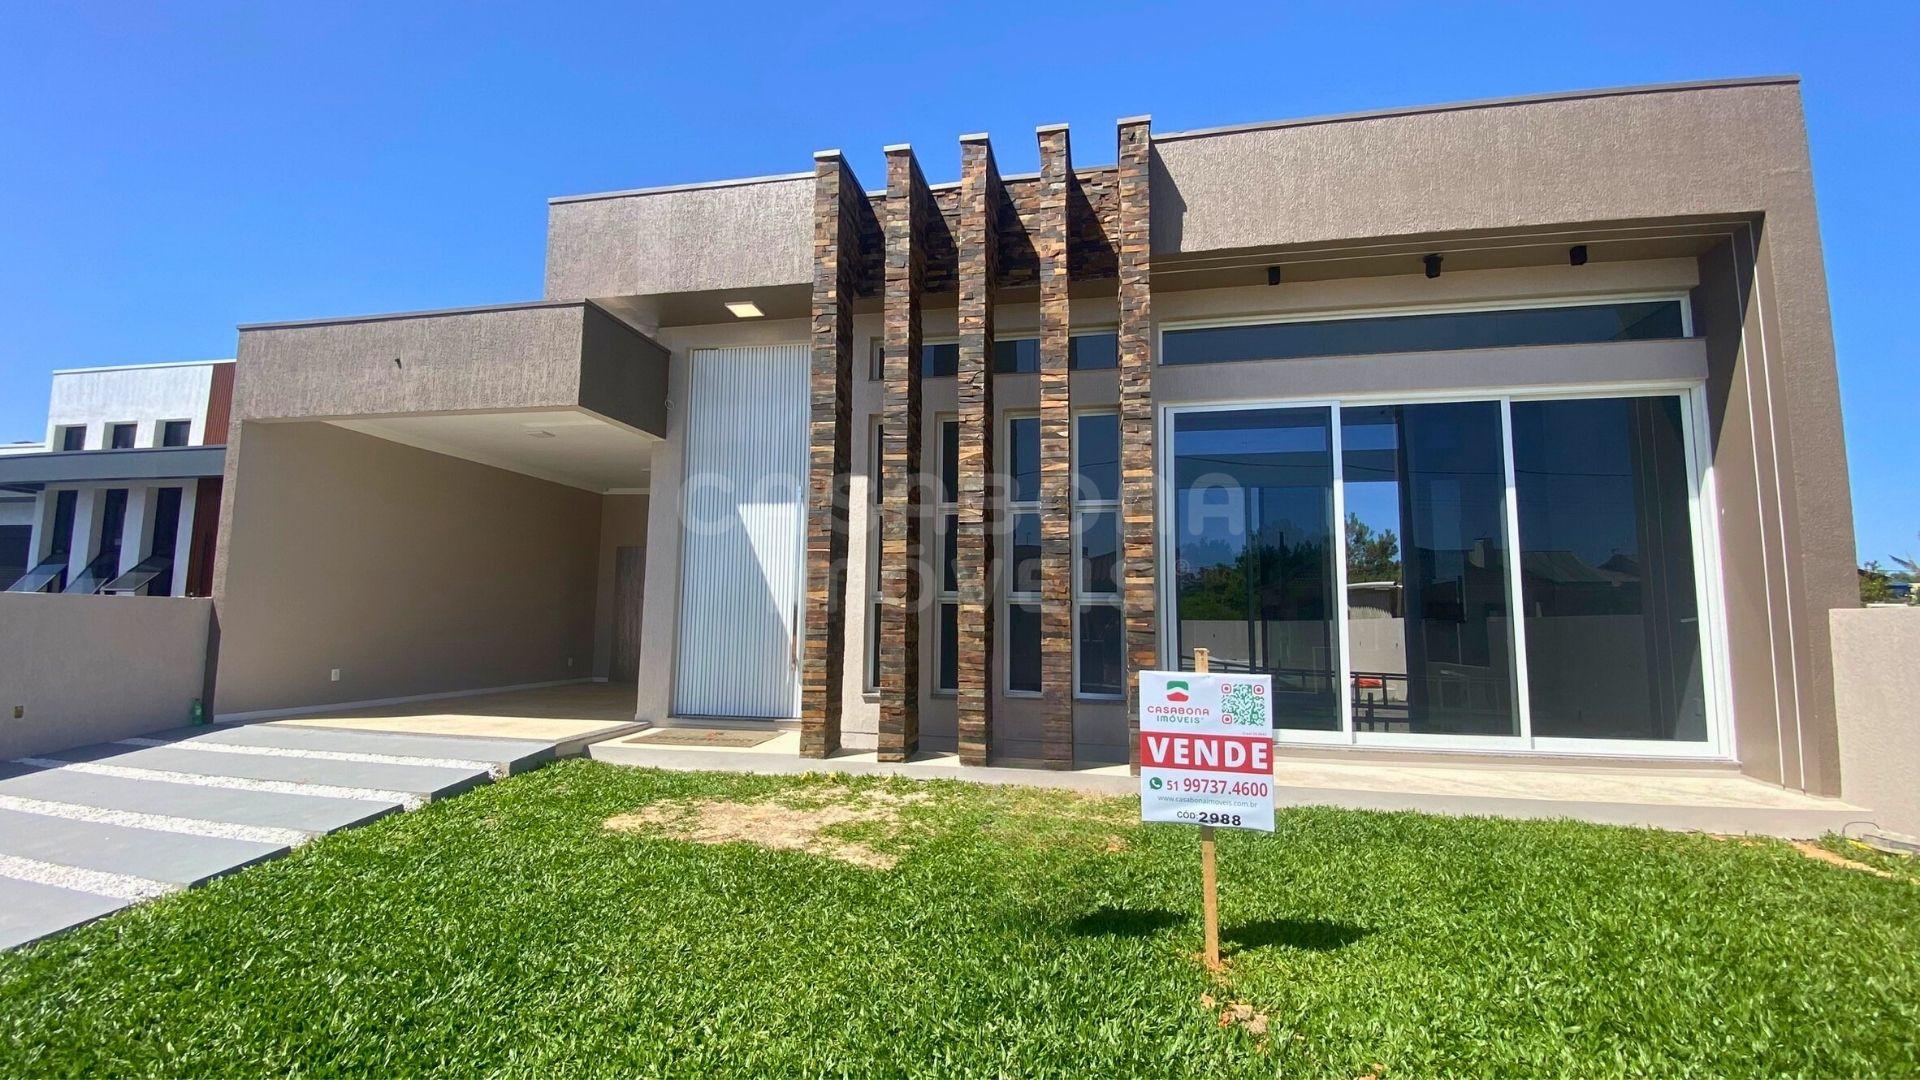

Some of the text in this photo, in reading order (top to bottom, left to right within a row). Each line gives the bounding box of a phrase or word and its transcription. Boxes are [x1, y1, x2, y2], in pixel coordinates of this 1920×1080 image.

[1147, 705, 1209, 716] CASABONA
[1156, 714, 1200, 724] IMÓVEIS
[1147, 736, 1268, 770] VENDE
[1166, 778, 1268, 797] 51 99737.4600
[1158, 795, 1258, 808] www.casabonaimoveis.com.br
[1198, 811, 1242, 826] 2988
